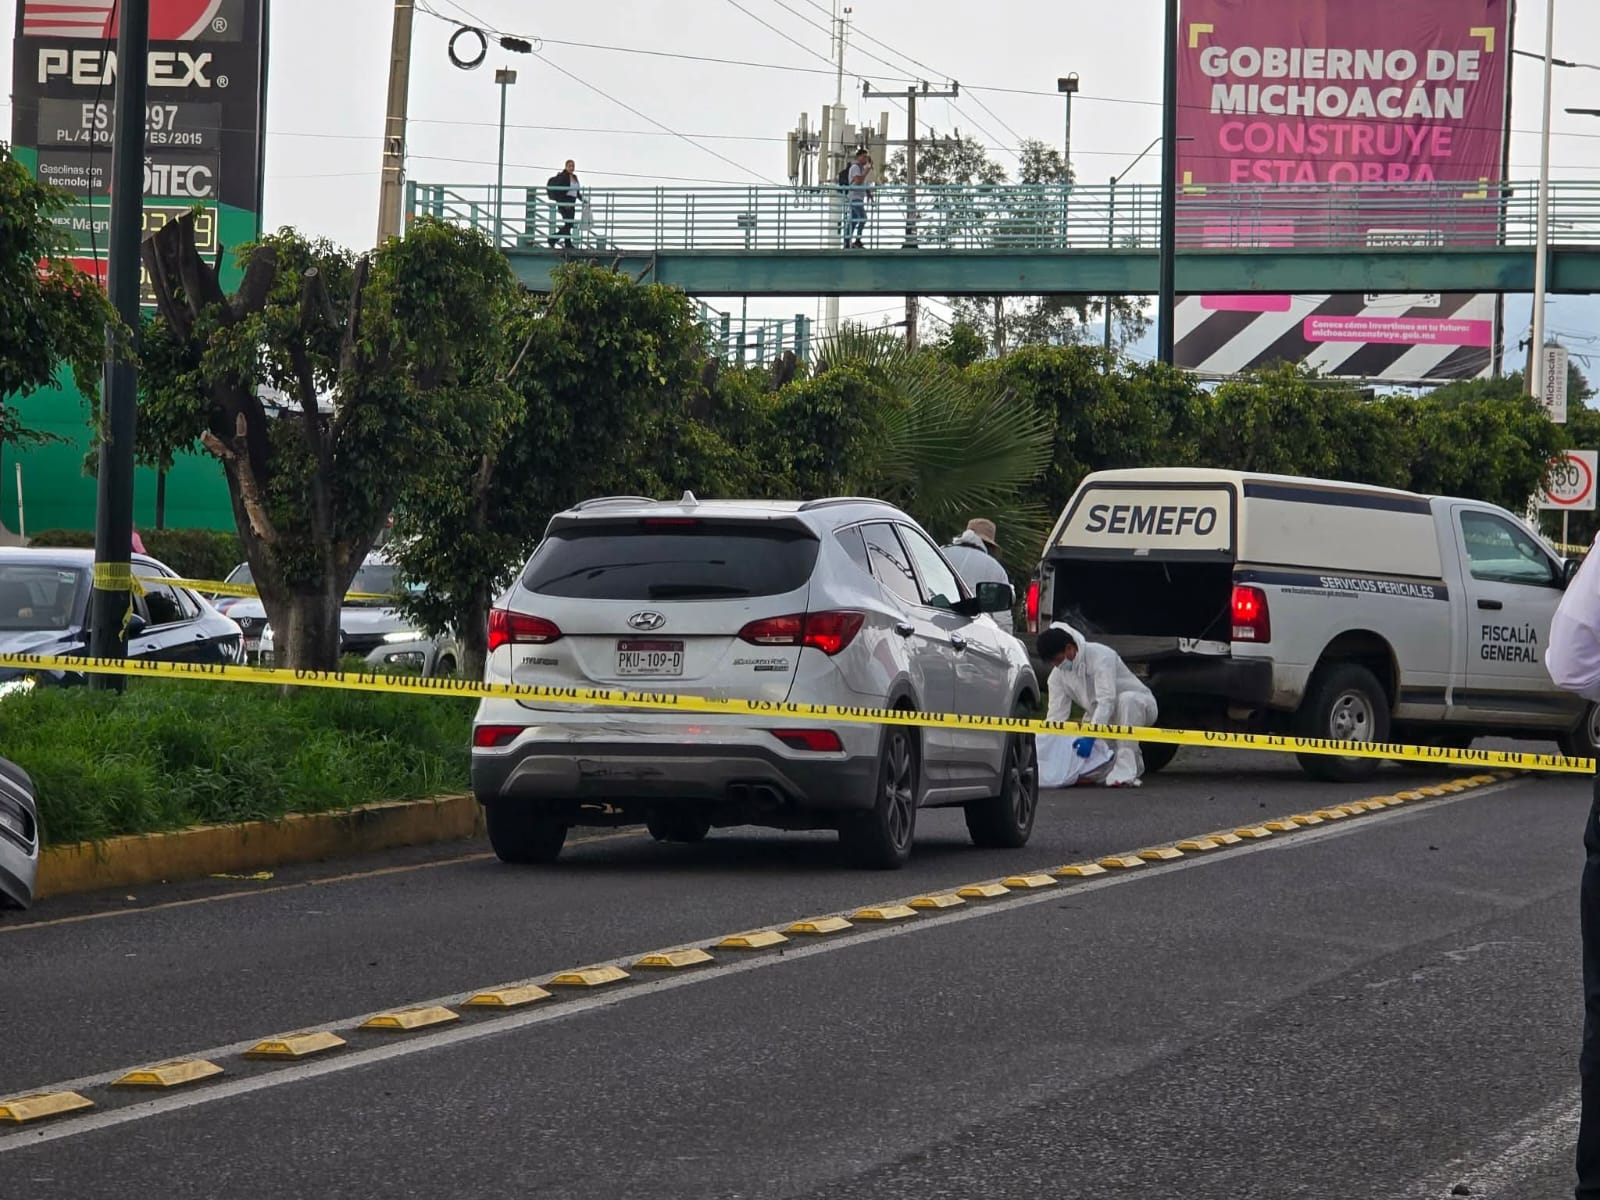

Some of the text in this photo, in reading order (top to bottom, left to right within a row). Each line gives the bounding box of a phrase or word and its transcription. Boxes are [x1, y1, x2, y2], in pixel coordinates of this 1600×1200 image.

[1200, 46, 1480, 80] GOBIERNO DE
[1210, 80, 1464, 118] MICHOACÁN
[82, 103, 108, 129] ES
[1219, 121, 1452, 157] CONSTRUYE
[39, 163, 84, 176] Gasolinas
[1229, 159, 1437, 192] ESTA OBRA
[72, 217, 109, 234] Magn
[1085, 504, 1217, 535] SEMEFO
[1319, 576, 1377, 592] SERVICIOS
[1377, 581, 1435, 598] PERICIALES
[1481, 623, 1538, 645] FISCALÍA
[618, 652, 681, 667] PKU-109-D
[1480, 644, 1539, 663] GENERAL
